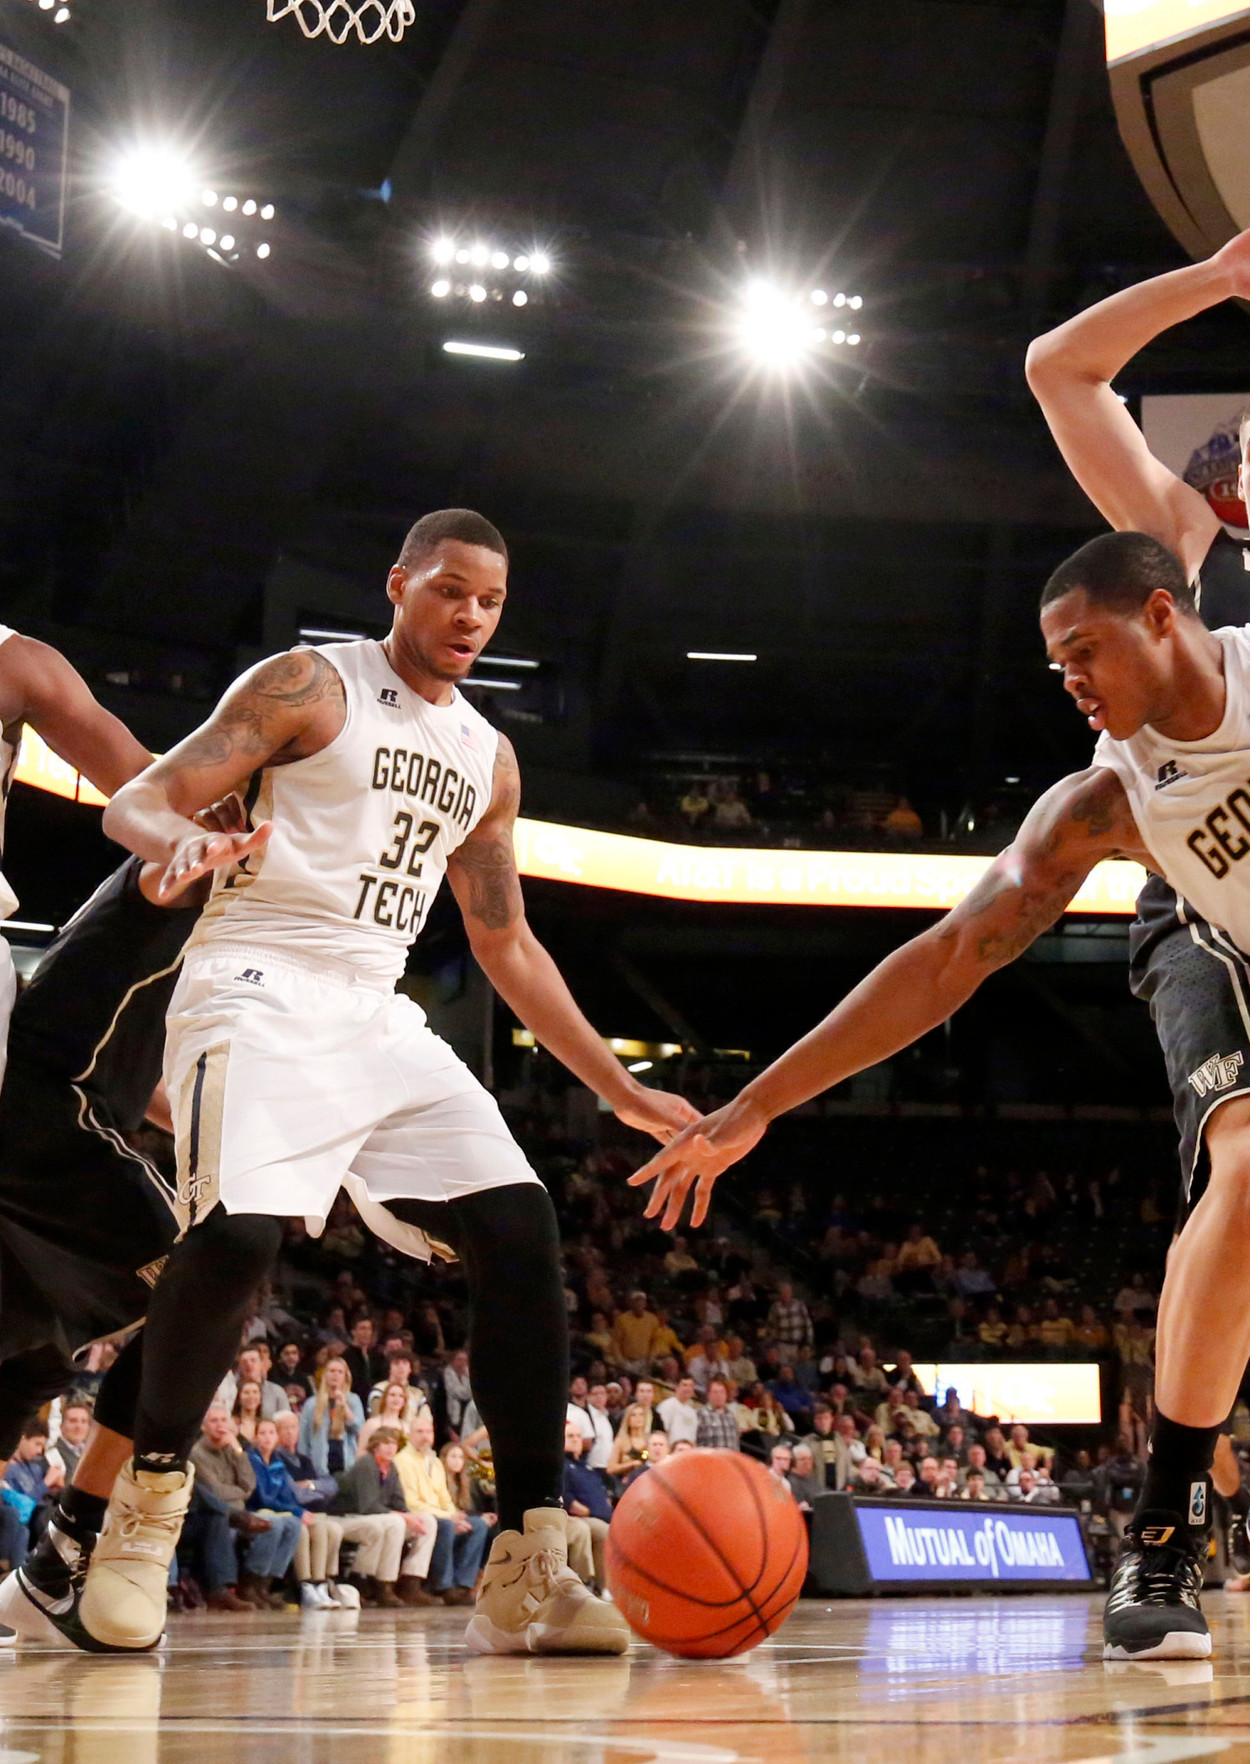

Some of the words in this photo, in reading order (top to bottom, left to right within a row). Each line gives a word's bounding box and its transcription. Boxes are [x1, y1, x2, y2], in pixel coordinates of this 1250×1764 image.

[0, 91, 36, 134] 1985
[371, 746, 476, 831] GEORGIA
[379, 810, 440, 878] 32
[655, 852, 740, 889] AT&T
[779, 864, 804, 892] a
[808, 859, 912, 895] Proud
[353, 873, 426, 936] TECH
[1188, 1050, 1244, 1098] WF
[973, 1517, 999, 1578] of
